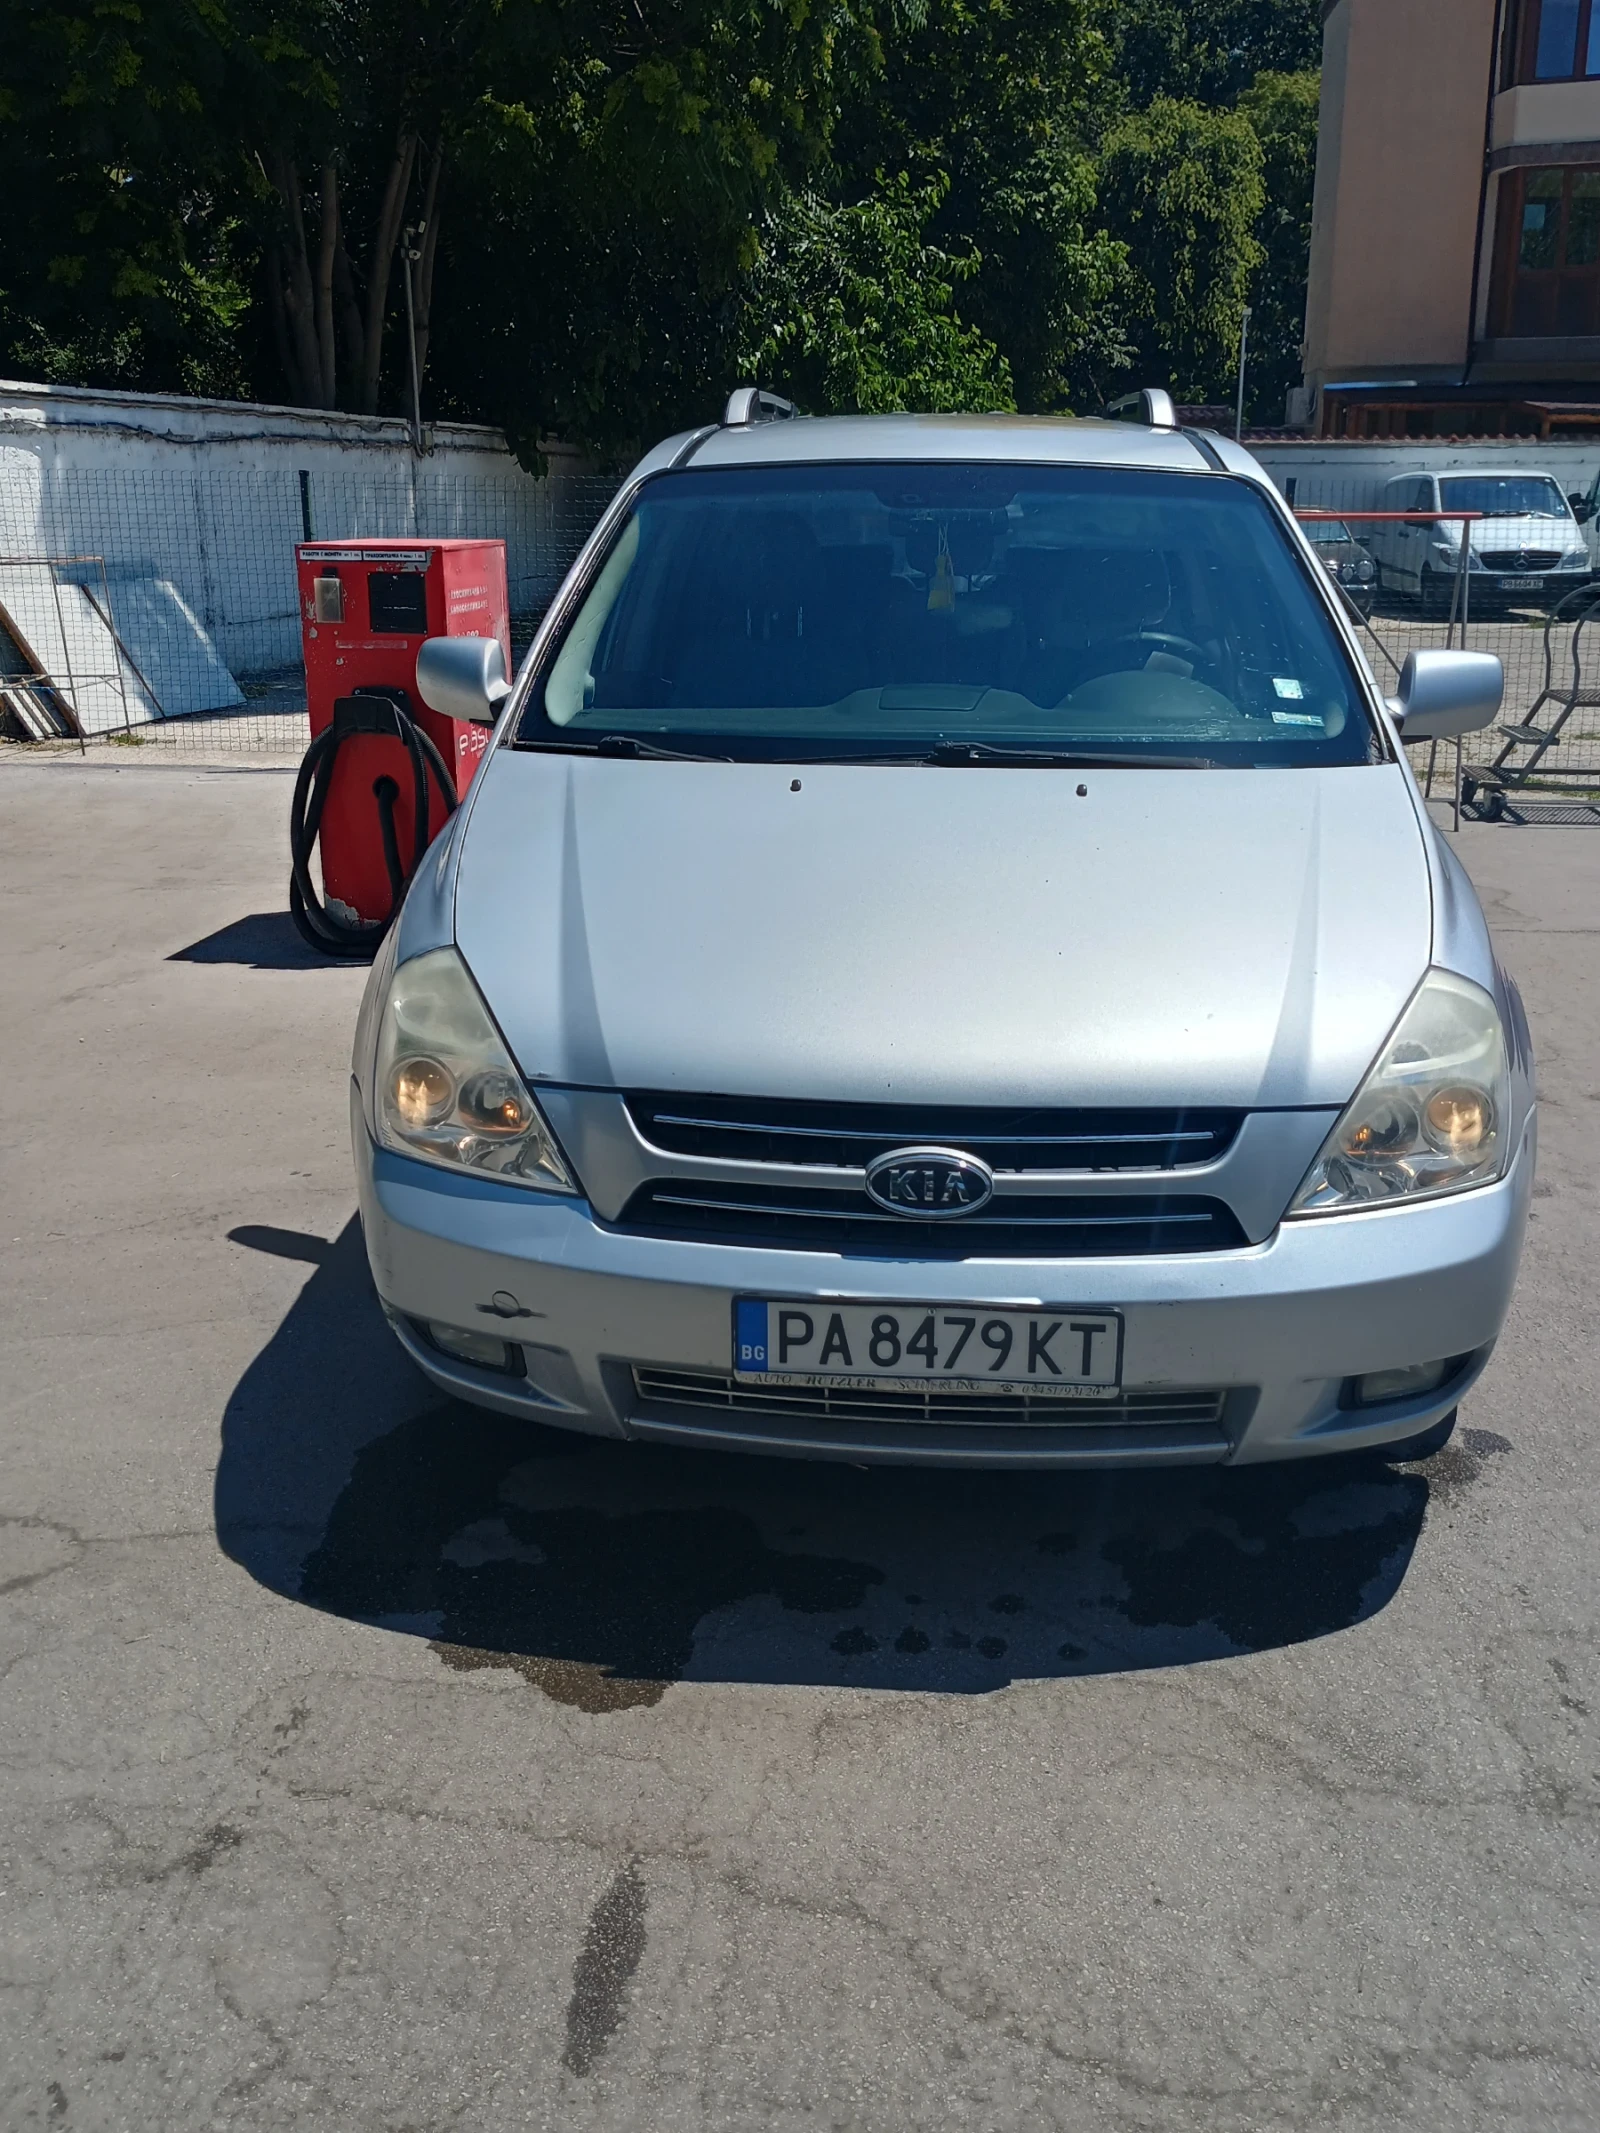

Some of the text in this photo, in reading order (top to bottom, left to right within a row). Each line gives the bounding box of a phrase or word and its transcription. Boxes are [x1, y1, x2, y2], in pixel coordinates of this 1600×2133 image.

[888, 1168, 970, 1203] KIA
[740, 1344, 765, 1361] BG
[753, 1373, 792, 1384] AUTO
